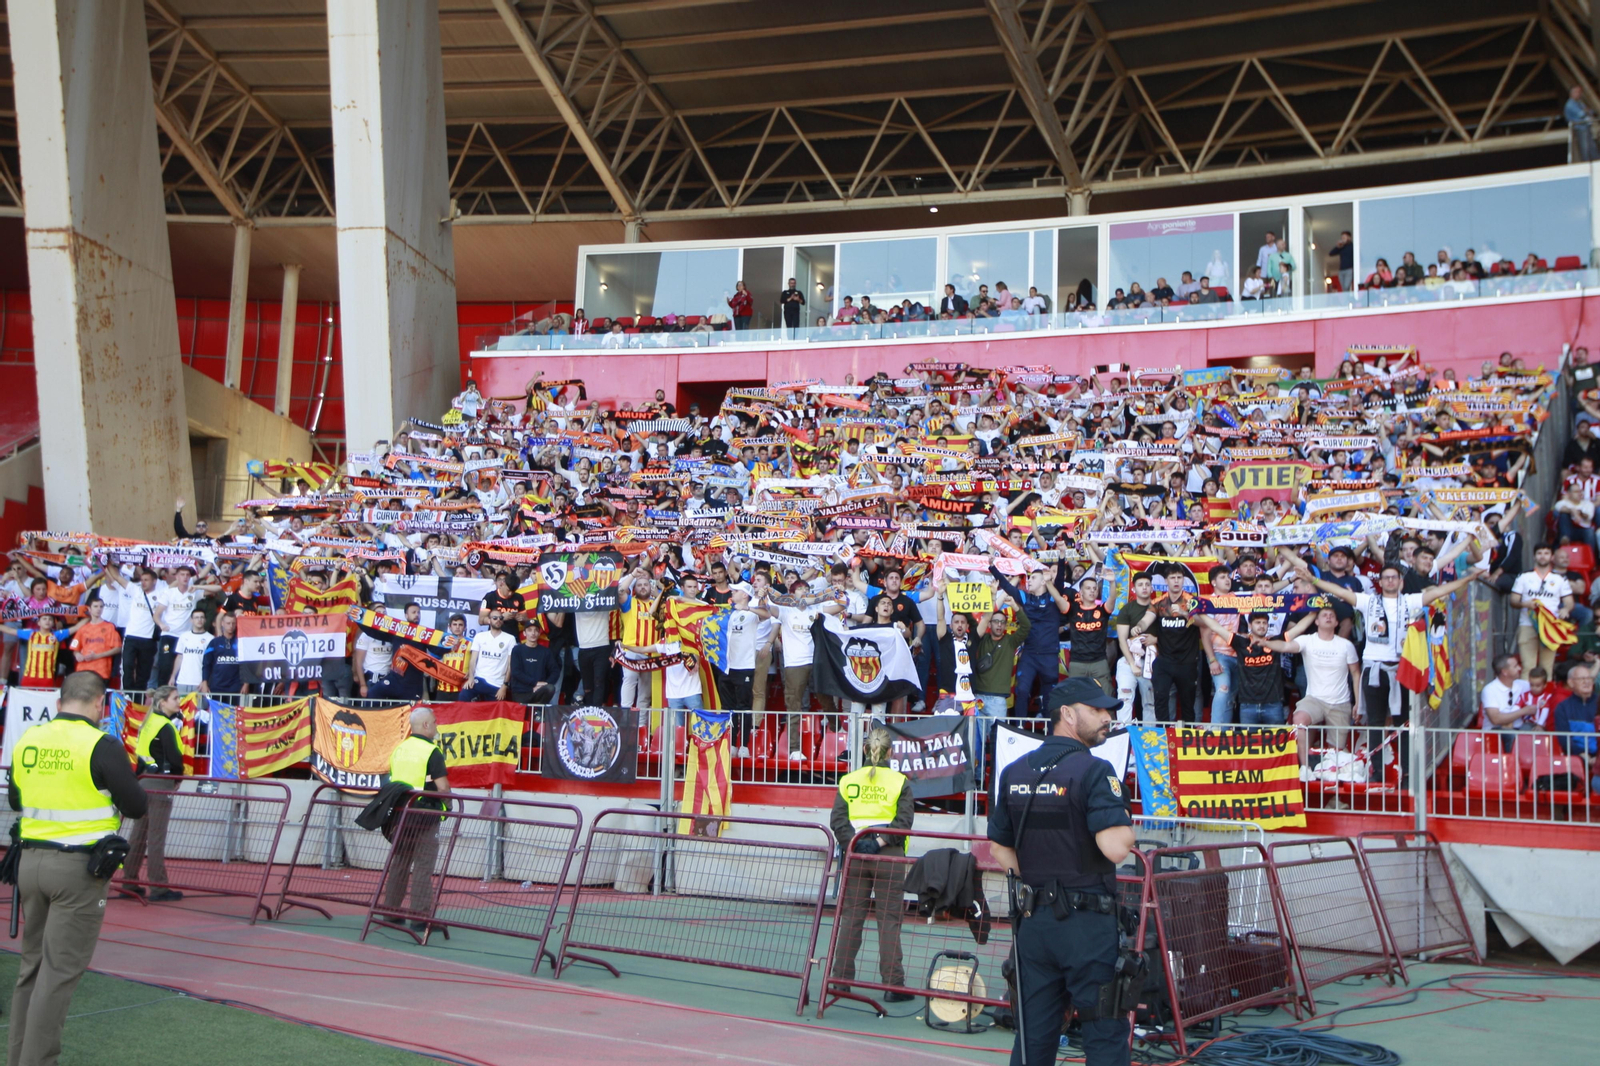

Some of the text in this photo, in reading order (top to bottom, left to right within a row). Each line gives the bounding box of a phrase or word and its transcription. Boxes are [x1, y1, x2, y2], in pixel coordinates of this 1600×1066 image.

[1147, 219, 1196, 231] Agroponiente
[913, 363, 957, 371] VALENCIA CF
[614, 411, 654, 419] AMUNT
[1020, 433, 1060, 444] VALENCIA
[916, 446, 957, 456] VALENCIA
[1231, 447, 1286, 457] VALENCIA CF
[913, 488, 939, 496] AMUNT
[946, 483, 976, 493] MUNT
[1437, 489, 1516, 501] VALENCIA CF
[820, 503, 863, 516] VALENCIA
[920, 496, 975, 512] AMUNT
[376, 512, 434, 521] CURVA NORD
[836, 517, 888, 527] VALENCIA
[408, 521, 450, 529] Valencia
[720, 531, 779, 541] VALENCIA
[783, 530, 799, 538] CF
[313, 536, 363, 547] VALENCIA
[789, 543, 824, 551] VALENCIA
[752, 551, 810, 565] VALENCIA CF
[956, 583, 982, 593] LIM
[1528, 589, 1554, 599] bwin
[414, 597, 471, 611] RUSSAFA
[542, 592, 616, 611] Youth Firm
[952, 602, 991, 610] HOME
[1209, 595, 1285, 608] VALENCIA C.F.
[2, 606, 78, 621] ANTIMADRIDISTA
[260, 615, 329, 629] ALBORAYA
[1075, 621, 1102, 630] CAZOO
[1161, 617, 1185, 628] bwin
[373, 615, 433, 641] VALENCIA CF
[183, 646, 204, 655] bwin
[258, 639, 335, 655] 46 120
[1244, 655, 1273, 664] CAZOO
[264, 665, 322, 680] ON TOUR
[574, 706, 609, 723] VALENCIA
[892, 733, 963, 753] TIKI TAKA
[1182, 727, 1288, 756] PICADERO
[40, 748, 70, 761] grupo
[38, 759, 74, 771] control
[890, 750, 967, 772] BARRACA
[1209, 769, 1264, 784] TEAM
[861, 785, 886, 794] grupo
[861, 792, 888, 801] control
